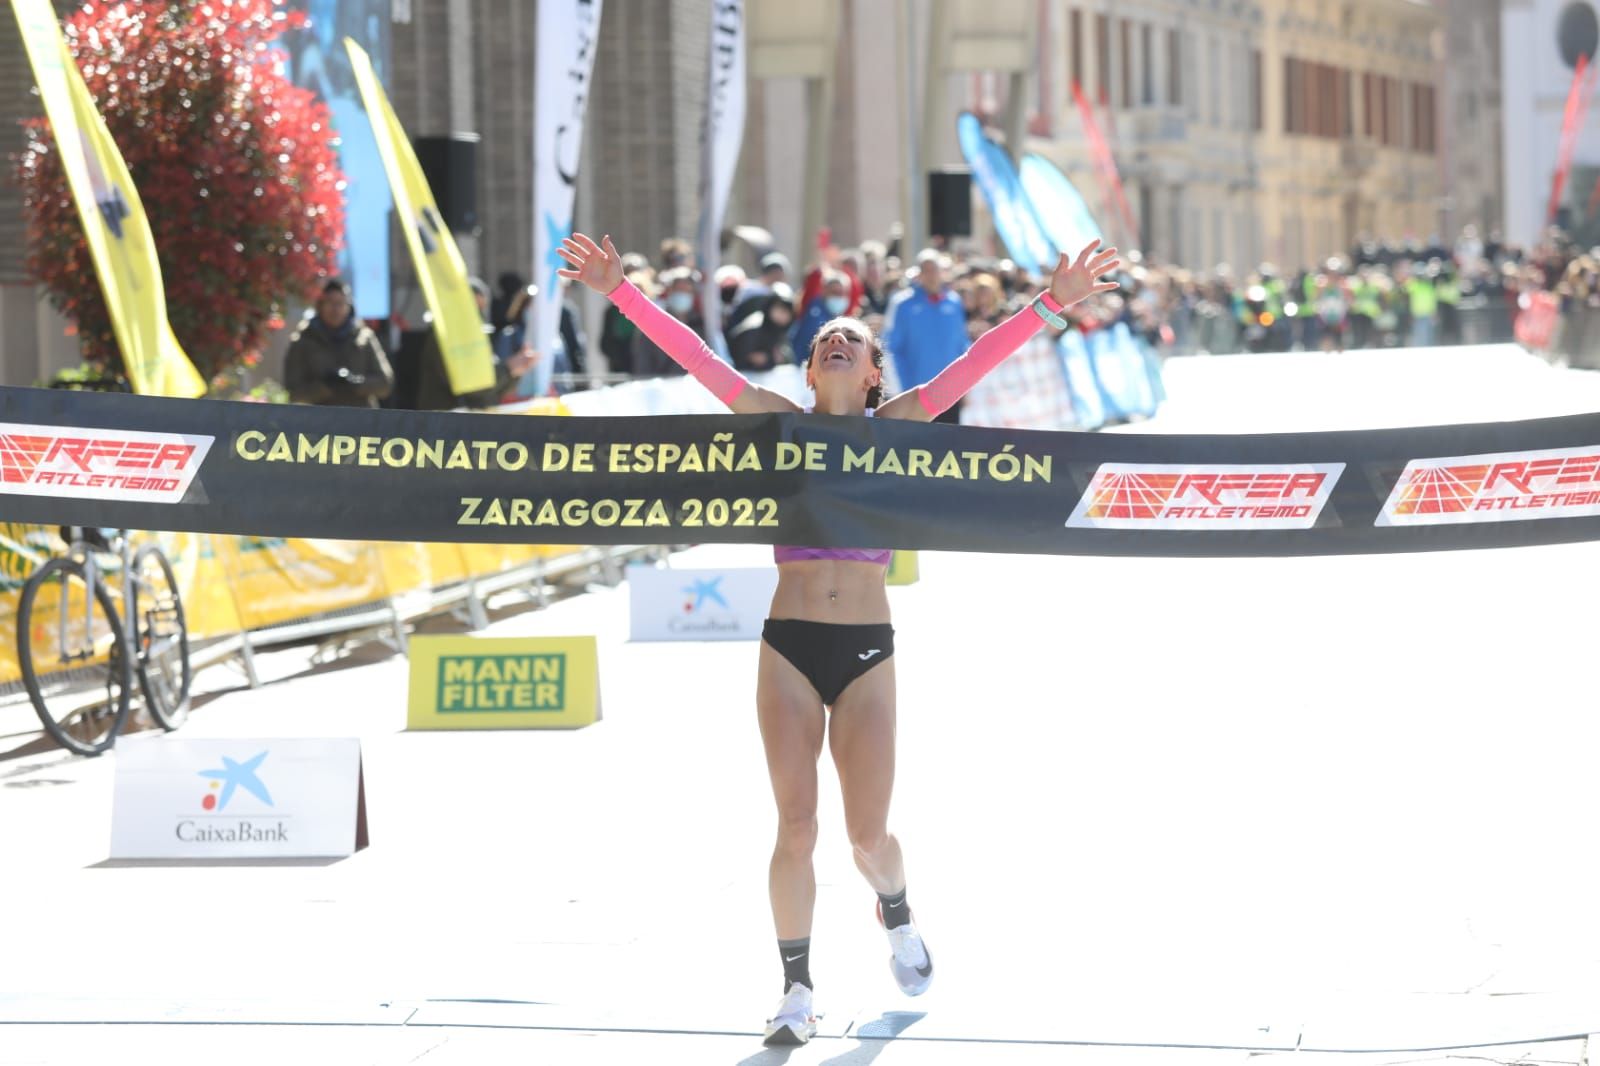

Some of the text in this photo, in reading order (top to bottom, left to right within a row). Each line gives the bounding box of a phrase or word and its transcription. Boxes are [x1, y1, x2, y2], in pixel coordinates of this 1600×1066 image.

[45, 437, 196, 472] RFEA
[235, 430, 1053, 483] CAMPEONATO DE ESPAÑA DE MARATÓN
[34, 471, 180, 491] ATLETISMO
[1173, 472, 1328, 505] RFEA
[1484, 455, 1600, 494] RFE
[457, 497, 779, 527] ZARAGOZA 2022
[1163, 504, 1312, 519] ATLETISMO
[444, 657, 559, 683] MANN
[443, 682, 559, 709] FILTER
[175, 820, 288, 844] CaixaBank
